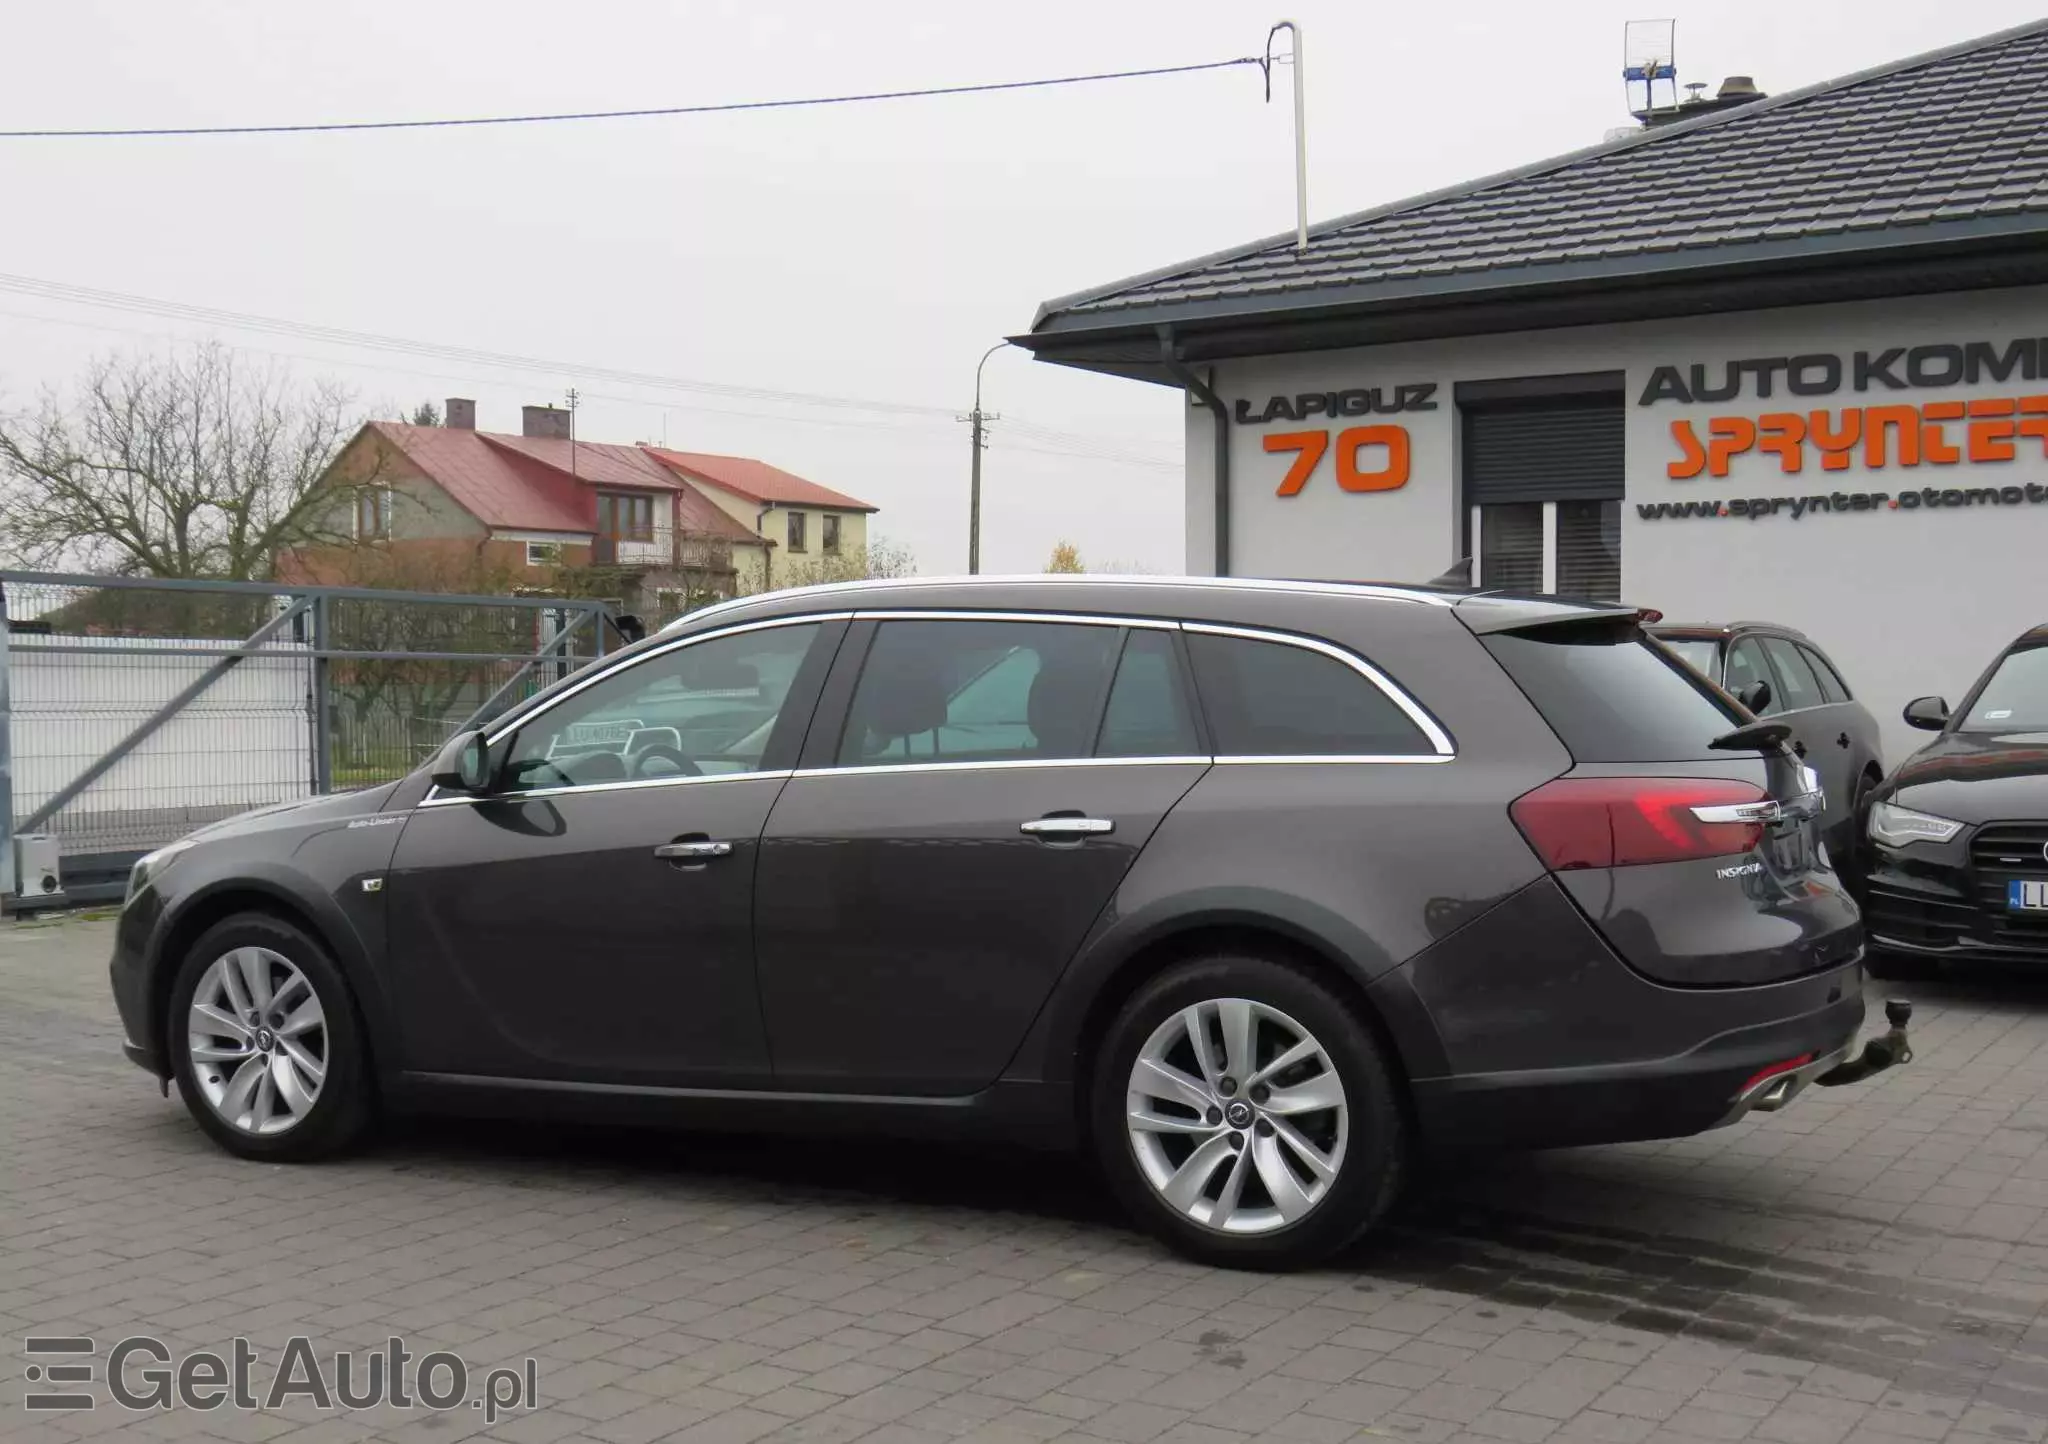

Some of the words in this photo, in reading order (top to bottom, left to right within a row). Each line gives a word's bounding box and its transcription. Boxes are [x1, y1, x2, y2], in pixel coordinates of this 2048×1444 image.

[1638, 353, 1842, 406] AUTO
[1263, 424, 1411, 497] 70
[1636, 482, 2048, 521] www.sprynter.otomot
